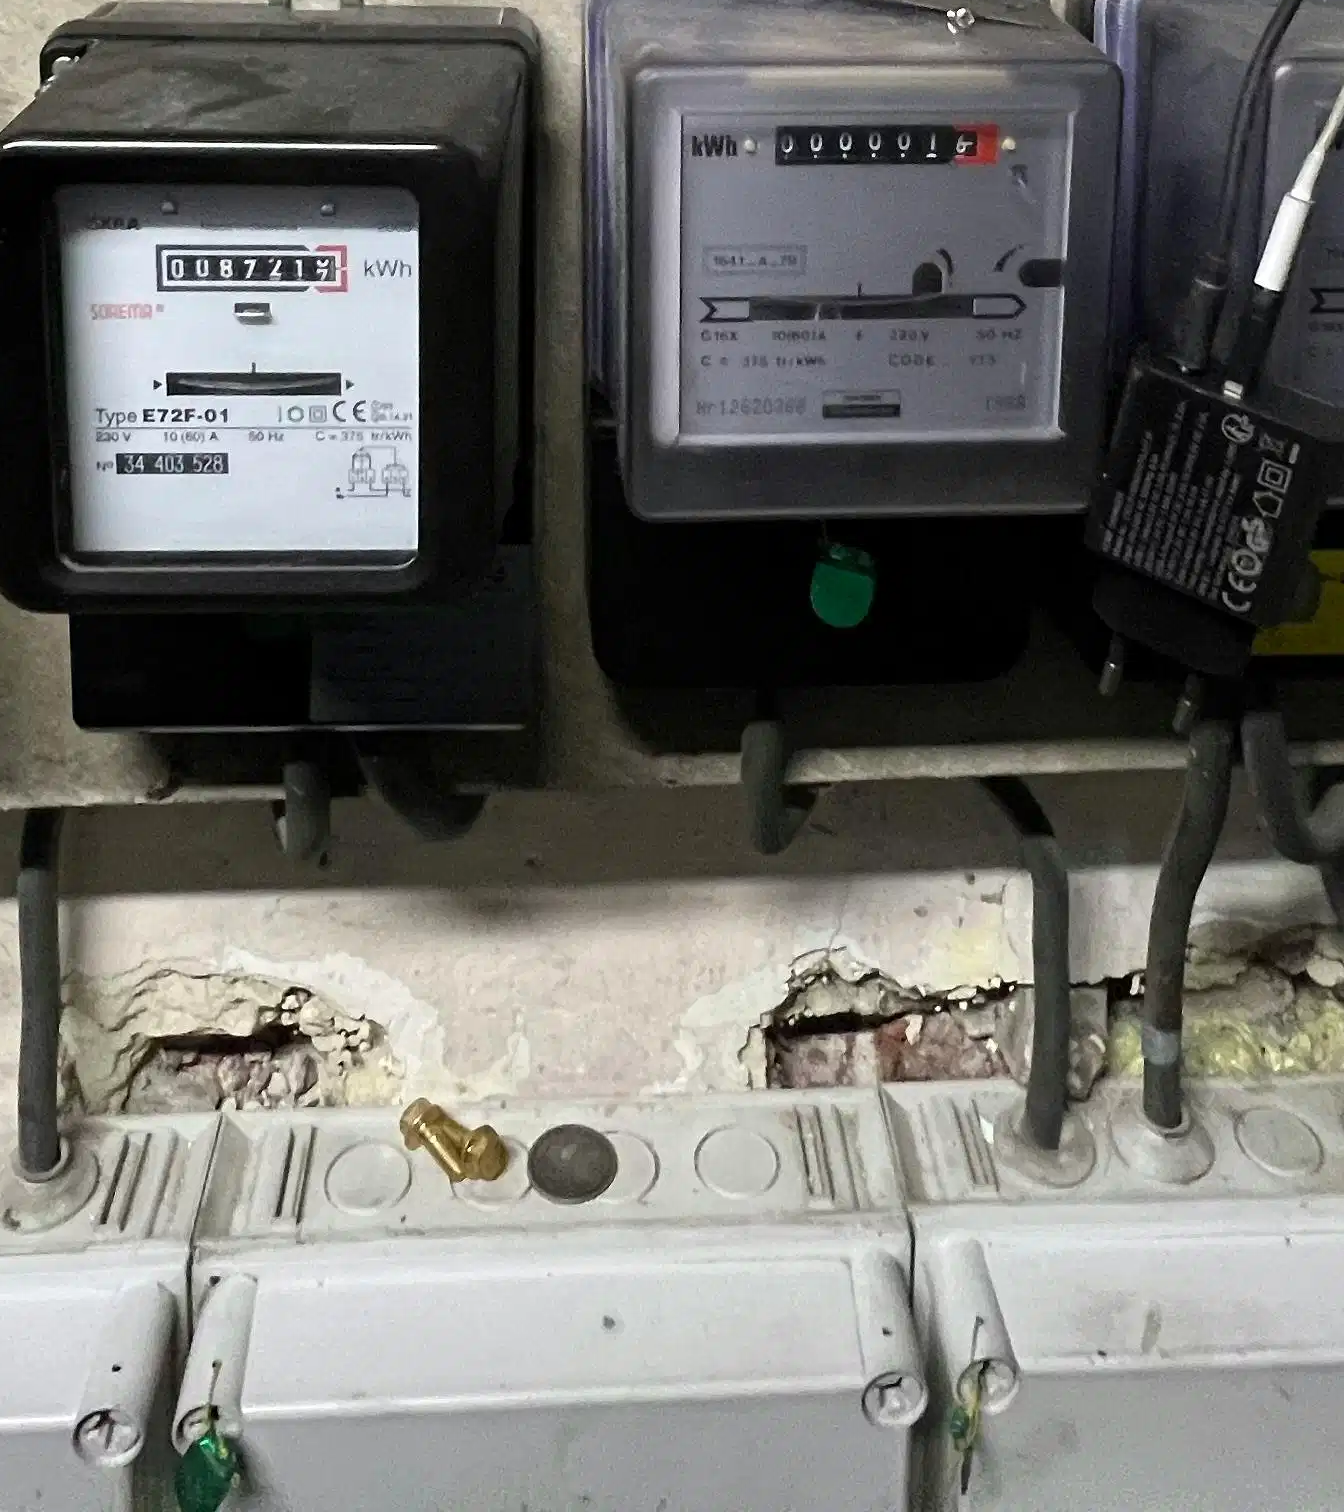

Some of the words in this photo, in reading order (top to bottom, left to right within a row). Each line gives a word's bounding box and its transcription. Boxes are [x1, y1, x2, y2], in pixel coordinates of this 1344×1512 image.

[692, 135, 738, 157] kWh
[364, 260, 412, 279] kWh
[96, 408, 137, 427] Type
[142, 408, 229, 423] E72F-01
[333, 400, 366, 422] CE
[124, 455, 144, 473] 34
[155, 455, 184, 473] 403
[193, 455, 223, 473] 528
